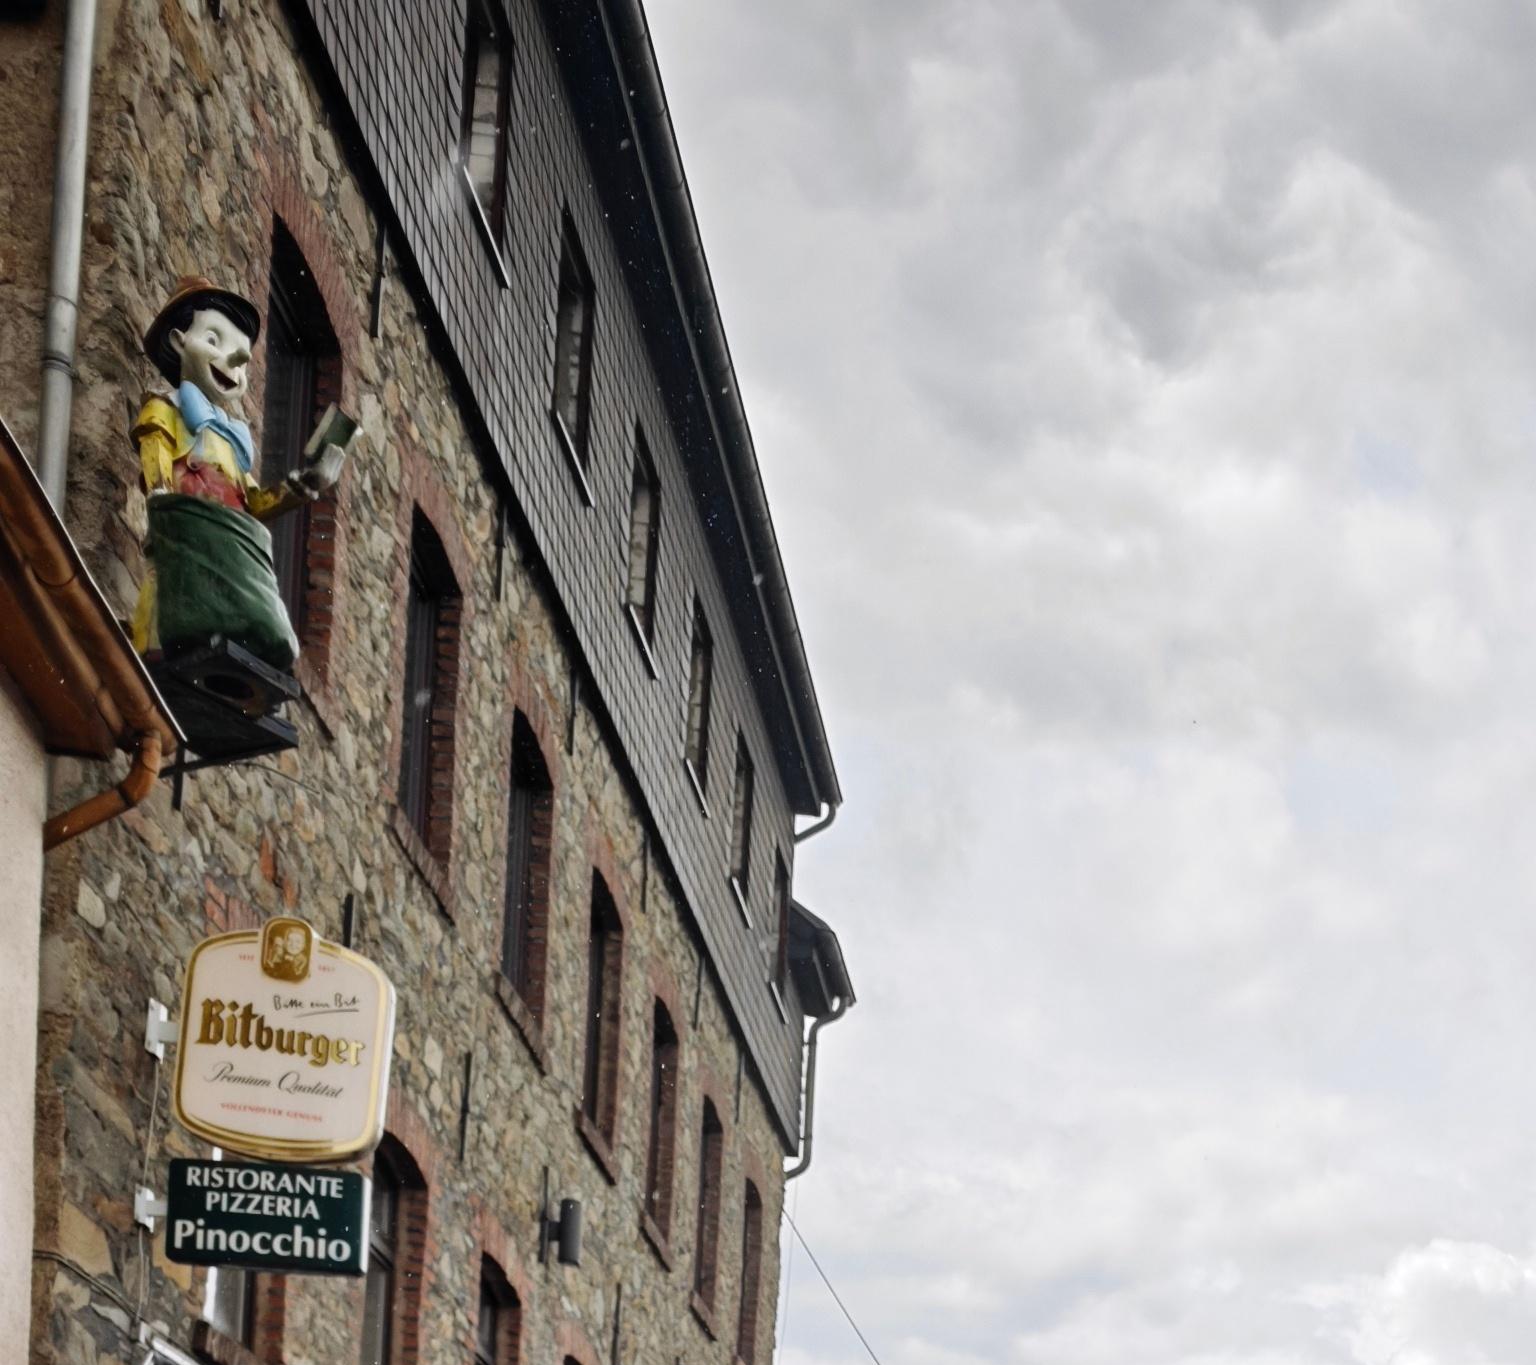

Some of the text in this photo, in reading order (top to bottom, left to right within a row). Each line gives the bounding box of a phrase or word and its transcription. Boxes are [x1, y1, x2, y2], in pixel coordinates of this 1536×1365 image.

[195, 997, 366, 1068] Bitburger
[203, 1060, 344, 1100] Premium Qualität
[186, 1165, 344, 1200] RISTORANTE
[205, 1190, 321, 1221] PIZZERIA
[173, 1217, 352, 1263] Pinocchio
